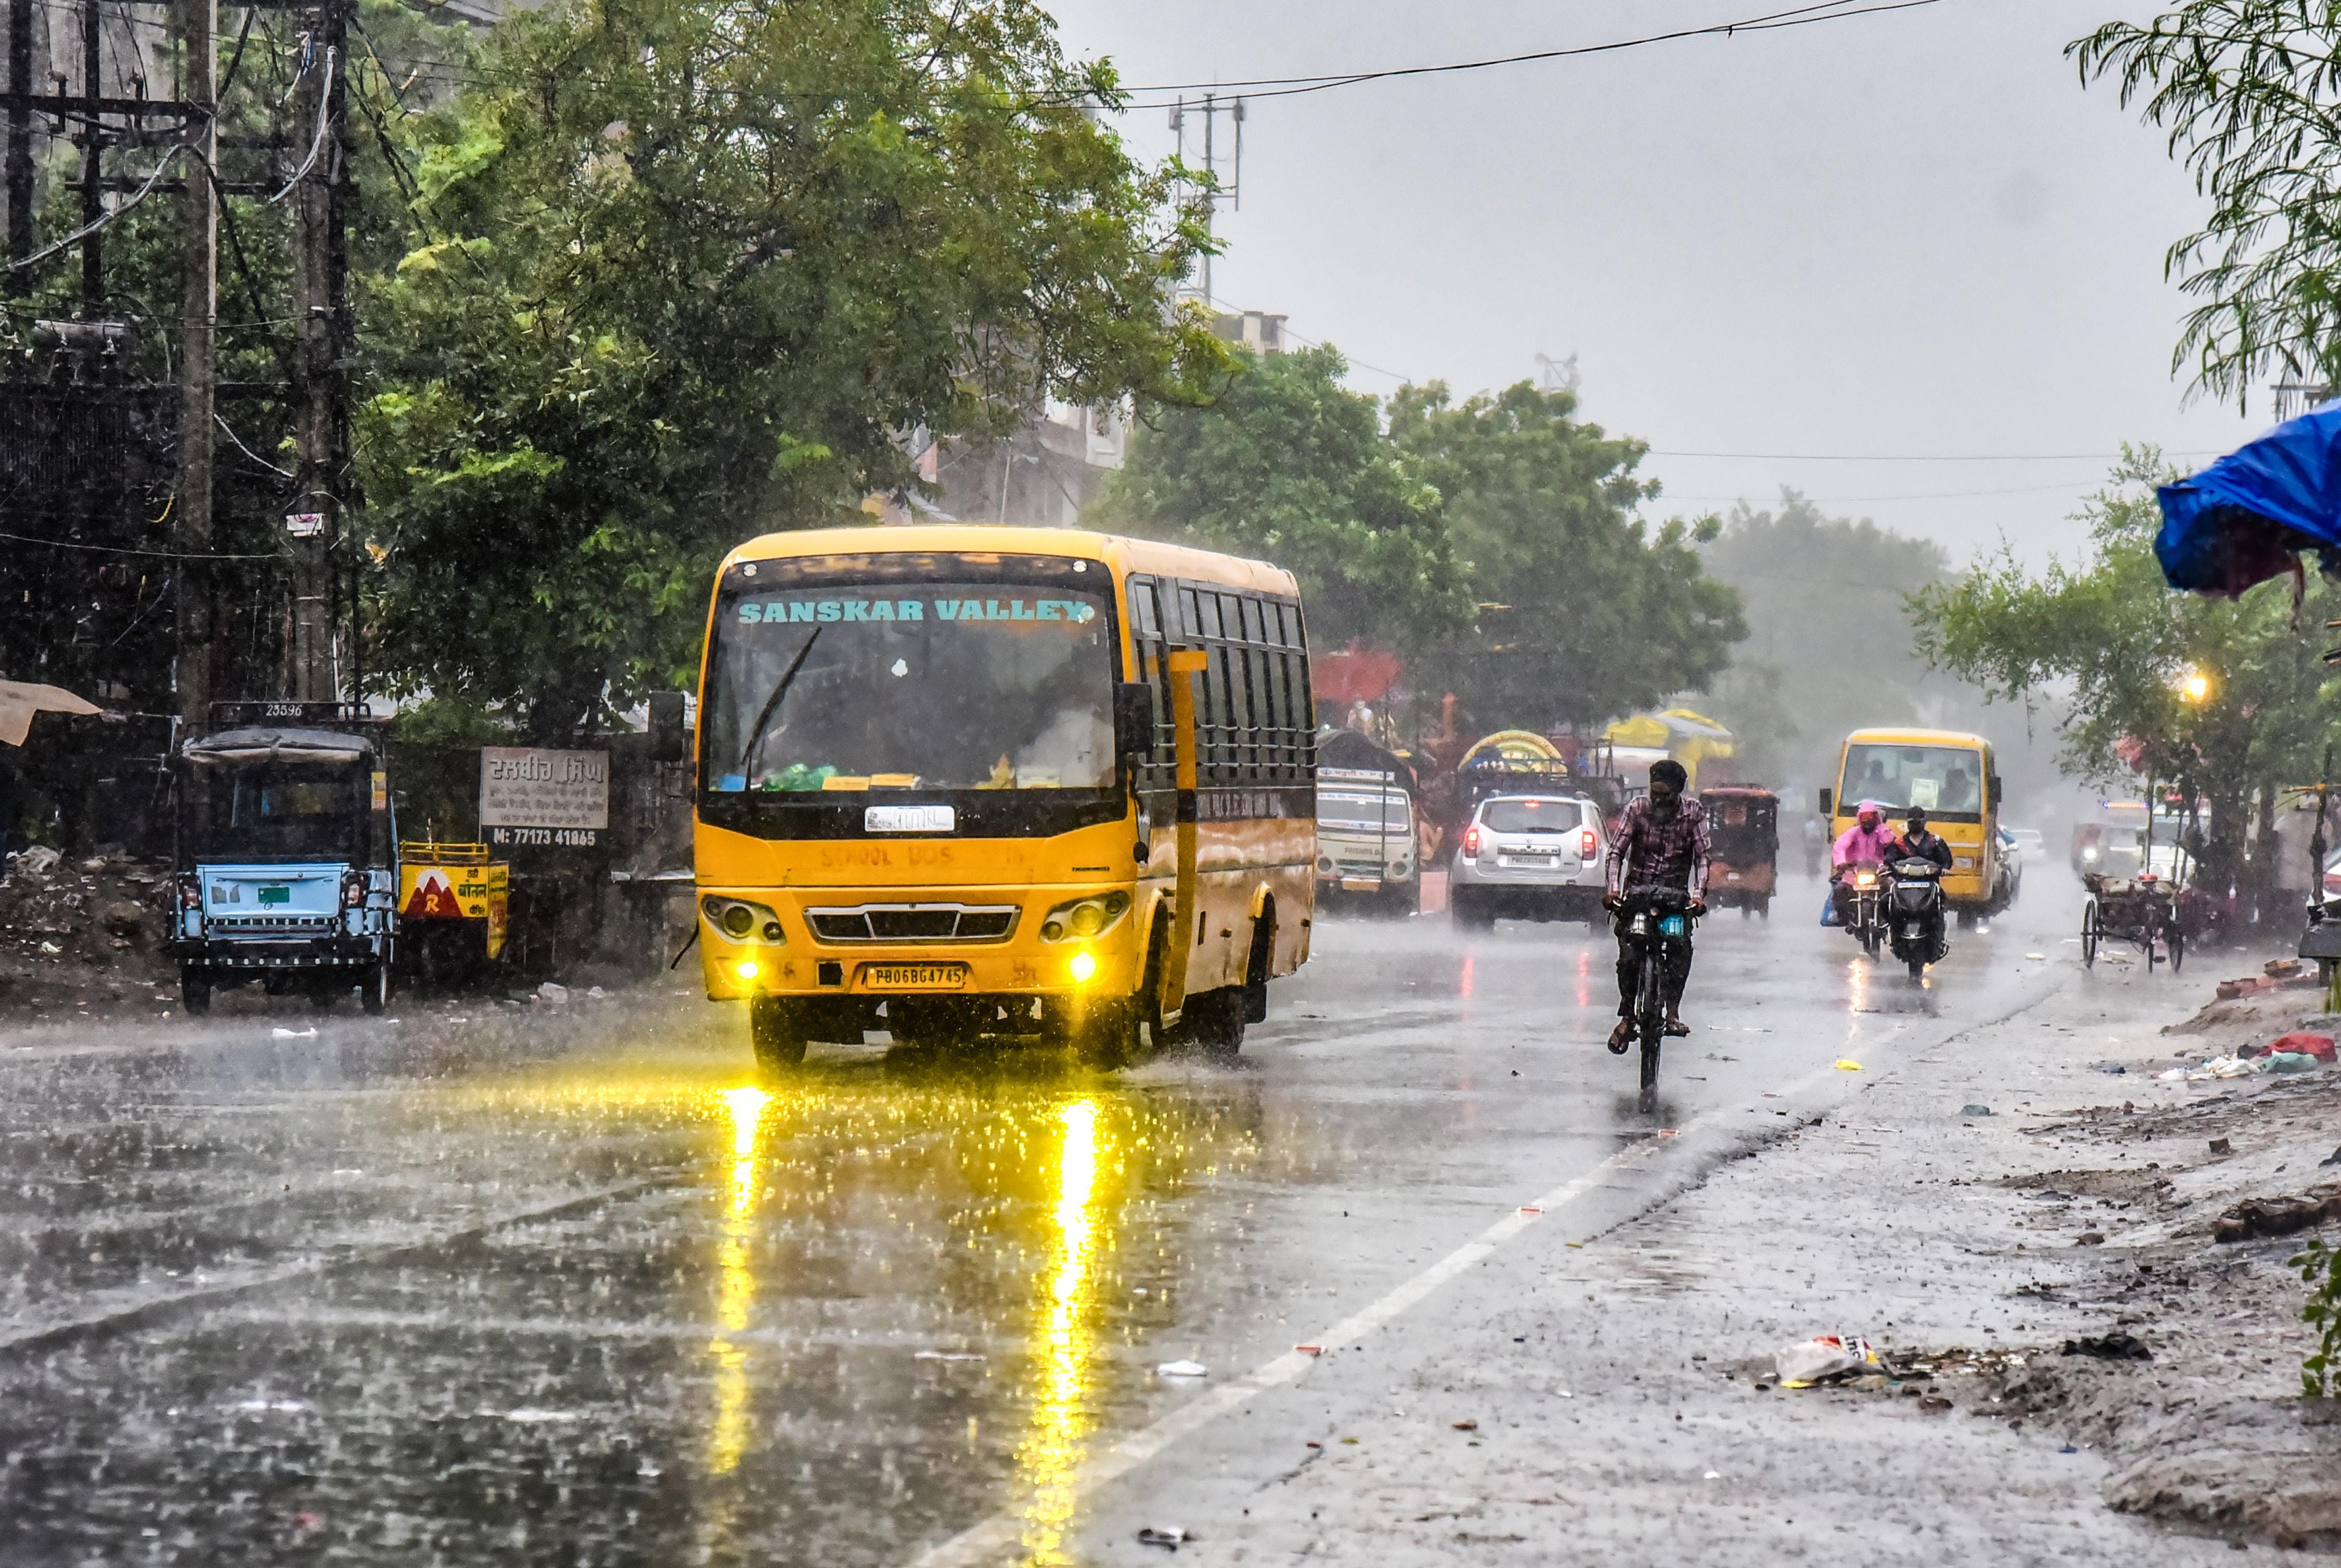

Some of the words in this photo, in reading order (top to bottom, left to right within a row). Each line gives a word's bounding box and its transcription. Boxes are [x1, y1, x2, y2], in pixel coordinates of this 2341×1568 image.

[738, 600, 924, 624] SANSKAR
[934, 600, 1087, 621] VALLEY
[266, 704, 303, 717] 23596
[494, 828, 510, 844] M:
[514, 828, 551, 845] 77173
